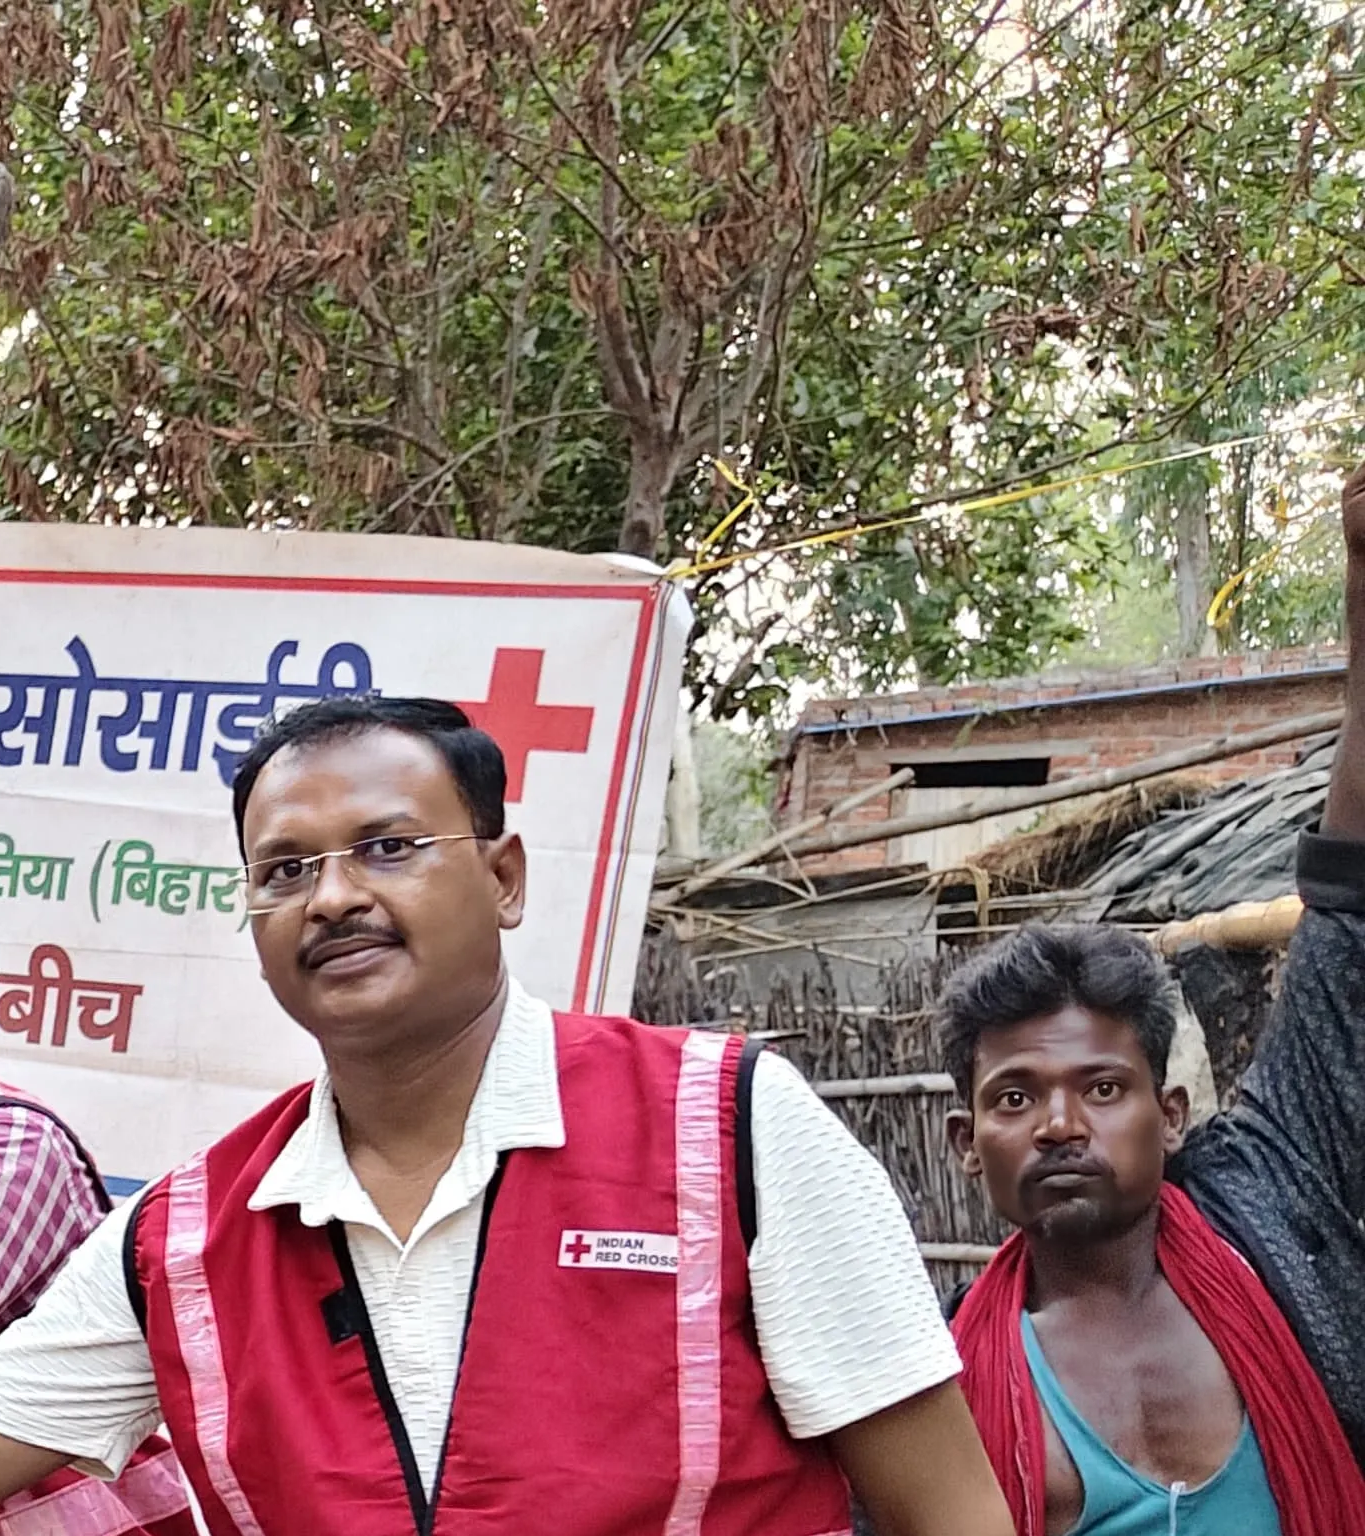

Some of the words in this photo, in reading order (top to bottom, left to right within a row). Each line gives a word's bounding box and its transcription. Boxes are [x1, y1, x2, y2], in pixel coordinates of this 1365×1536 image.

[596, 1237, 645, 1250] INDIAN
[595, 1252, 622, 1263] RED
[627, 1254, 678, 1267] CROSS
